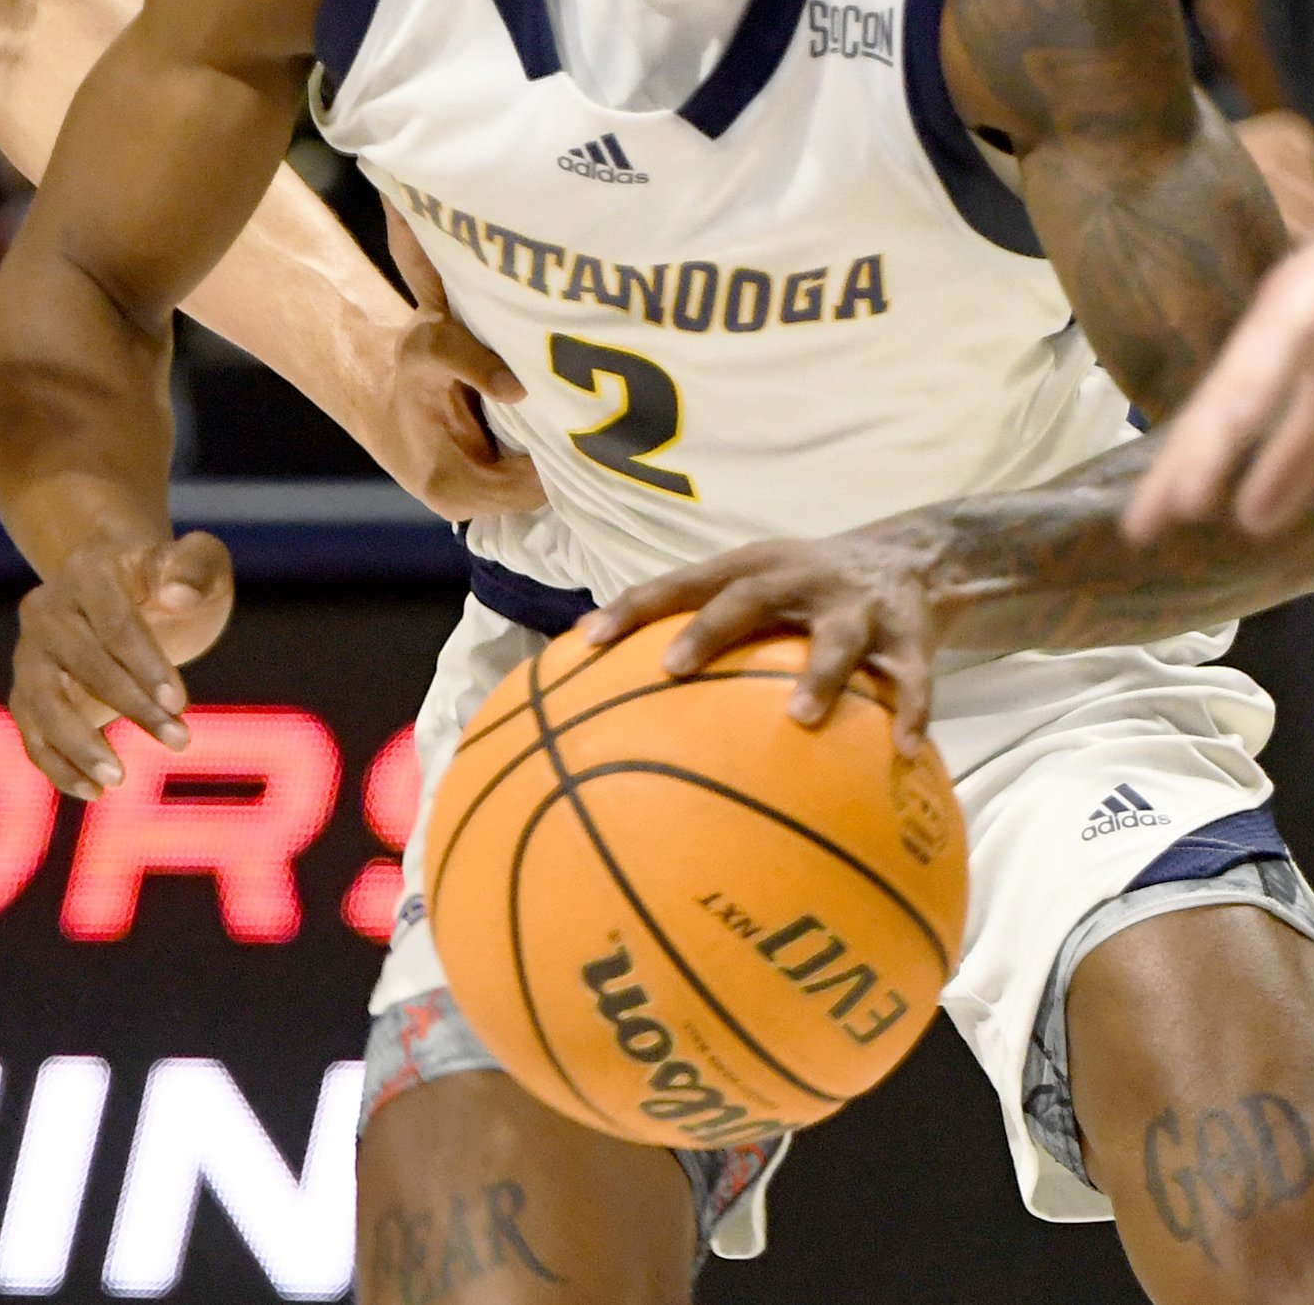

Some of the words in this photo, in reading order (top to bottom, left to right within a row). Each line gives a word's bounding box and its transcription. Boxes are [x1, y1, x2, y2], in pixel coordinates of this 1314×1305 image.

[556, 154, 650, 185] adidas
[545, 331, 700, 502] 2
[1081, 809, 1172, 842] adidas
[694, 891, 763, 940] NXT
